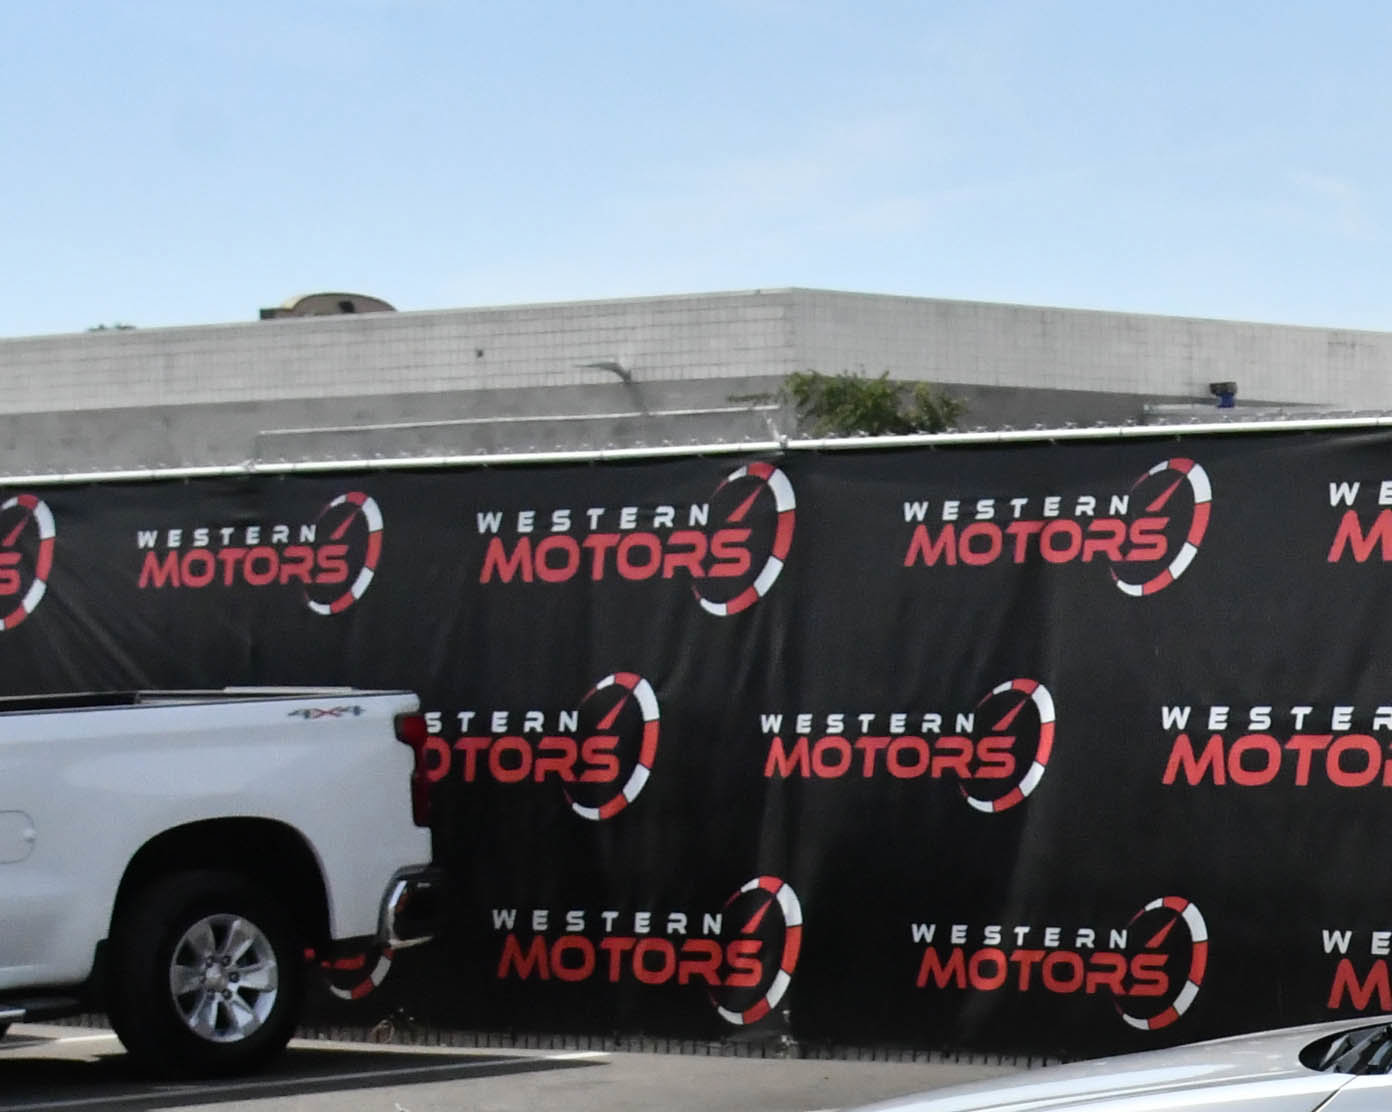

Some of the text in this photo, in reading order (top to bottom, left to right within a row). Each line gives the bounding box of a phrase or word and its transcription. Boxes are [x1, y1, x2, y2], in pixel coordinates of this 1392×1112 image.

[478, 504, 709, 533] WESTERN
[904, 495, 1129, 522] WESTERN
[138, 525, 317, 548] WESTERN
[904, 517, 1168, 567] MOTORS
[138, 544, 348, 588] MOTORS
[480, 528, 751, 583] MOTORS
[761, 714, 974, 733] WESTERN
[764, 736, 1016, 779] MOTORS
[494, 910, 721, 935] WESTERN
[912, 924, 1127, 948] WESTERN
[499, 935, 763, 987] MOTORS
[917, 947, 1168, 997] MOTORS
